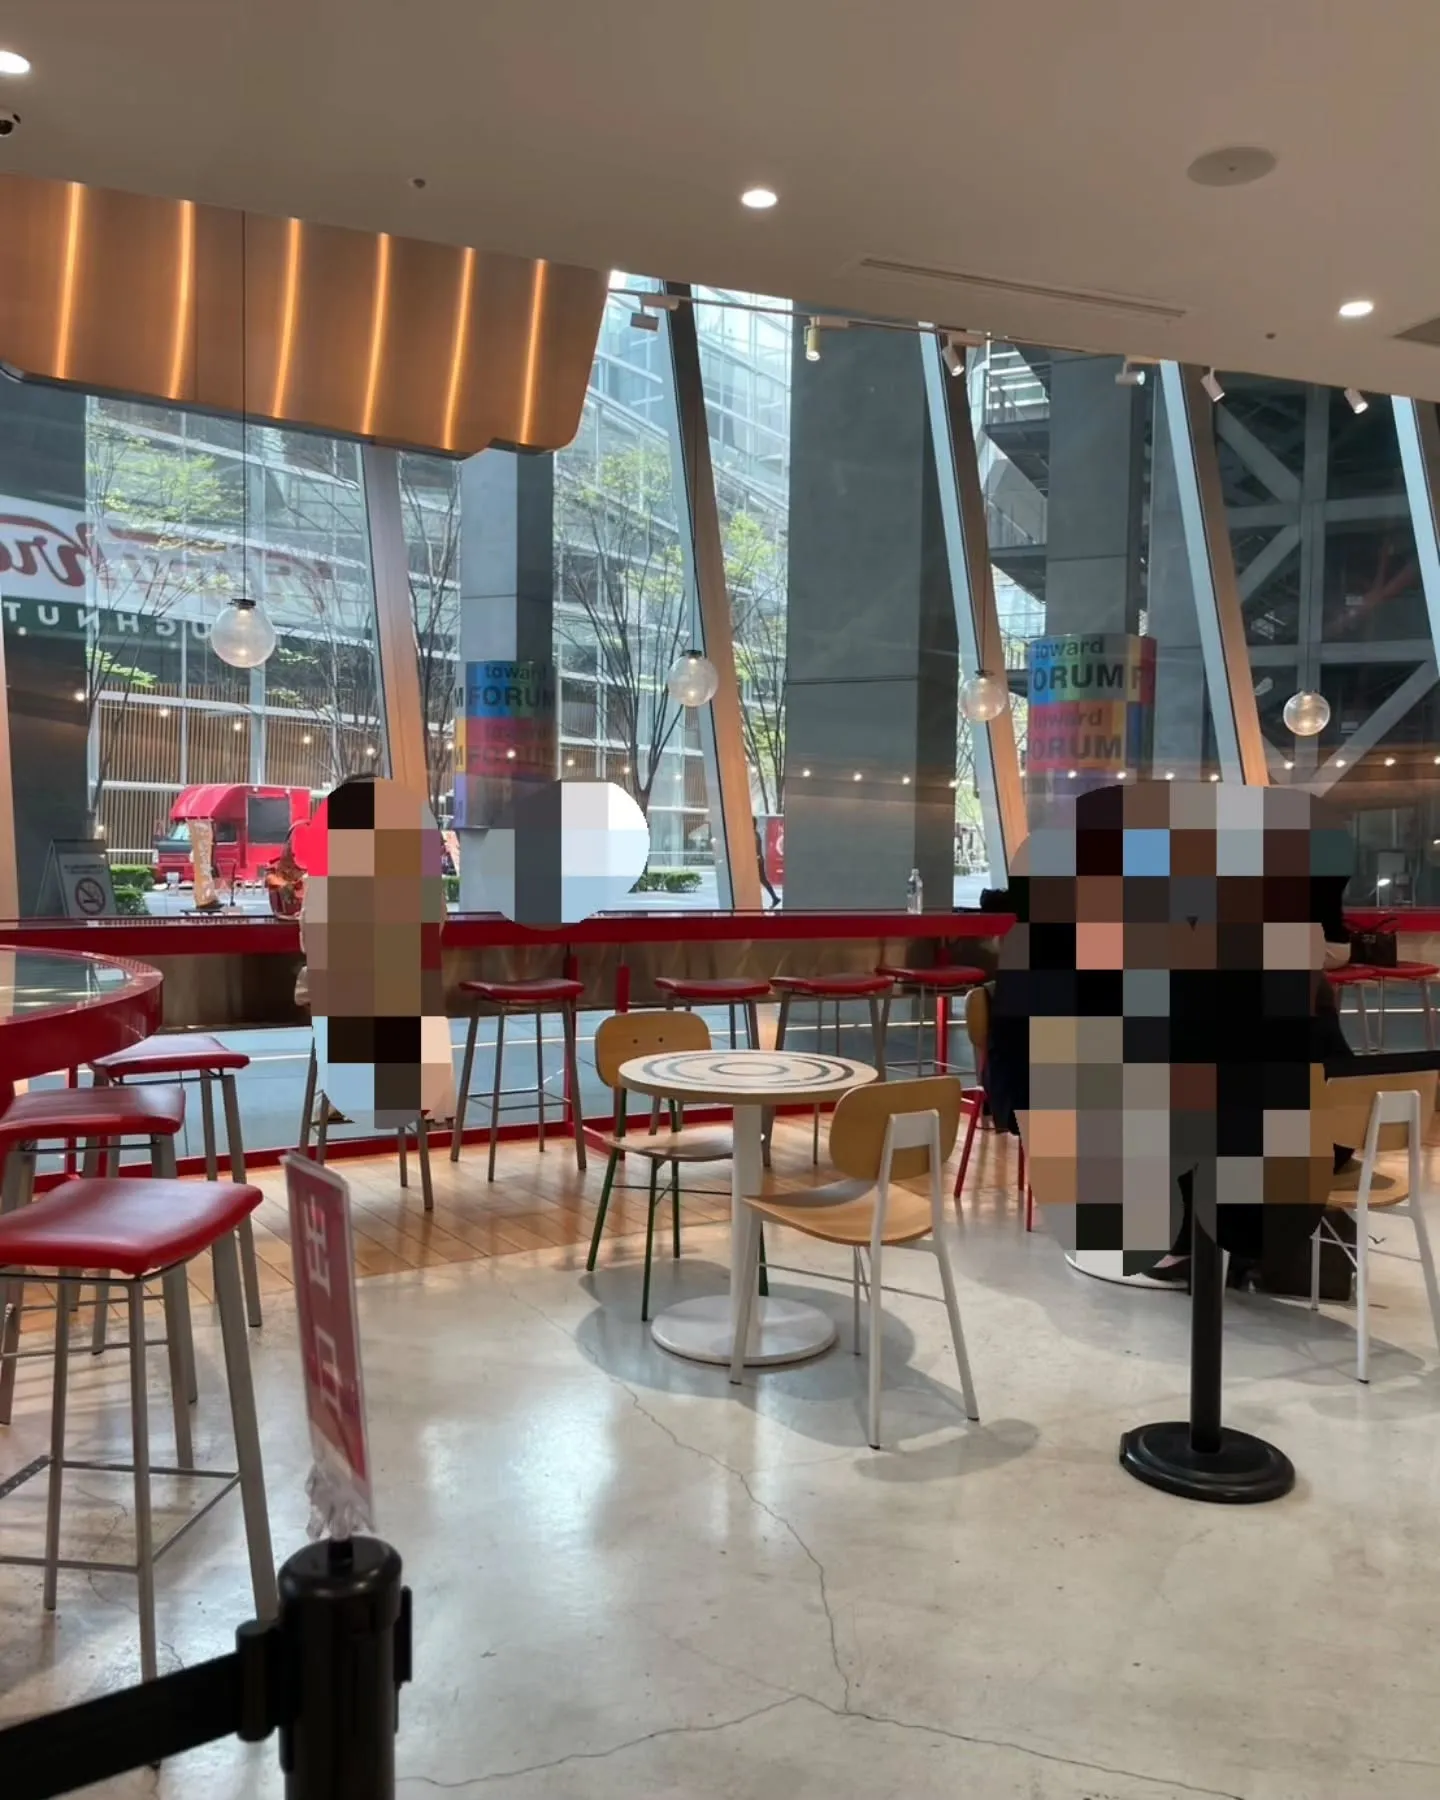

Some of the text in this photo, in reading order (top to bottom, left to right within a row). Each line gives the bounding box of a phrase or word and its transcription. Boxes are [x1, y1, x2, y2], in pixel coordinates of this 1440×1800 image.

[1035, 635, 1105, 659] toward
[1032, 664, 1124, 692] ORUM
[1031, 734, 1122, 761] ORUM
[303, 1194, 342, 1419] 出口
